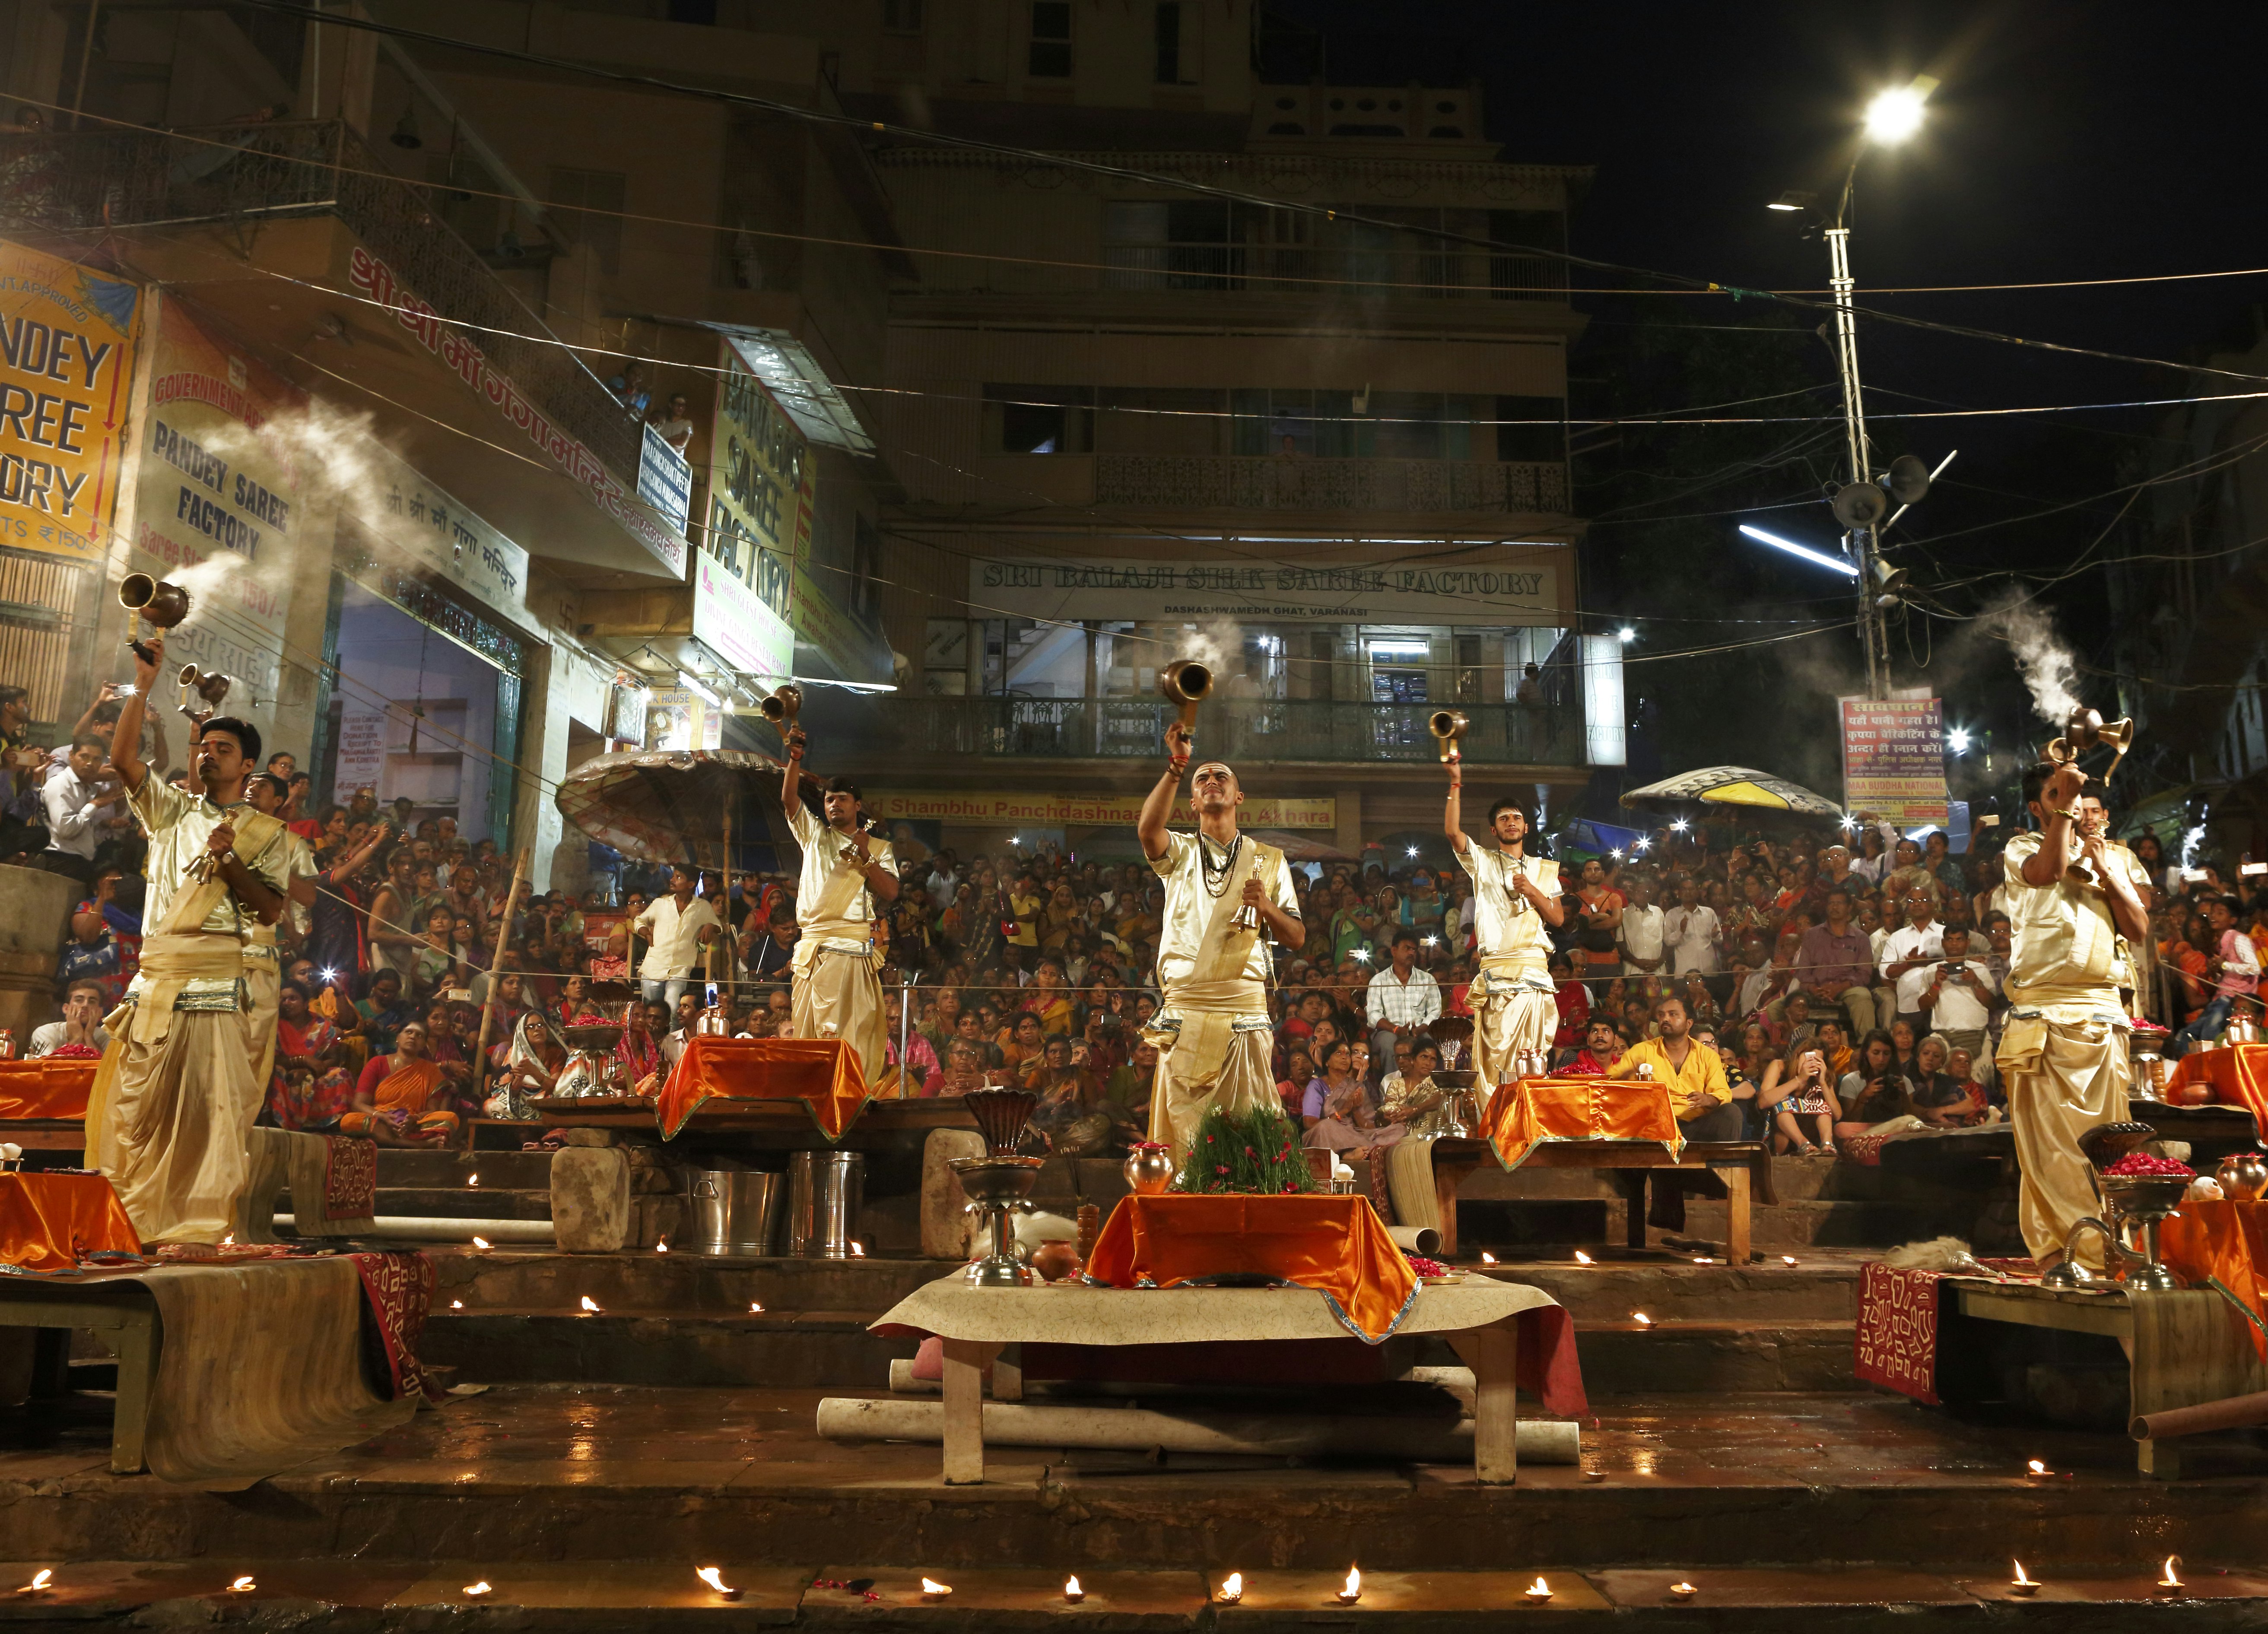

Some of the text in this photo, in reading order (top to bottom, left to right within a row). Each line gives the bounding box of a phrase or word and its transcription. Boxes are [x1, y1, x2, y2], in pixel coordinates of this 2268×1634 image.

[349, 247, 397, 316] श्री
[399, 292, 441, 355] श्री
[485, 368, 550, 452] गंगा
[155, 372, 244, 421] GOVERNMENT
[153, 420, 228, 495] PANDEY
[235, 473, 289, 533] SAREE
[725, 435, 784, 545] SAREE
[177, 485, 260, 561] FACTORY
[140, 521, 180, 565] Saree
[453, 520, 477, 555] गंगा
[483, 546, 517, 595] मन्दिर
[707, 492, 790, 619] FACTORY
[984, 564, 1543, 595] SRI BALAJI SILK SAREE FACTORY
[720, 578, 778, 640] SHRI GUEST HOUSE
[1165, 606, 1368, 617] DASHASHWAMEDH GHAT, VARANASI
[752, 638, 786, 676] RESTAURANT
[1584, 641, 1623, 657] BALAJI
[1593, 663, 1614, 679] SILK
[661, 693, 690, 704] HOUSE
[1586, 725, 1625, 742] FACTORY
[1878, 743, 1890, 753] ही
[1929, 729, 1941, 738] के
[1849, 781, 1945, 790] MAA BUDDHA NATIONAL
[890, 798, 987, 816] Shambhu
[1258, 807, 1330, 823] Akhara
